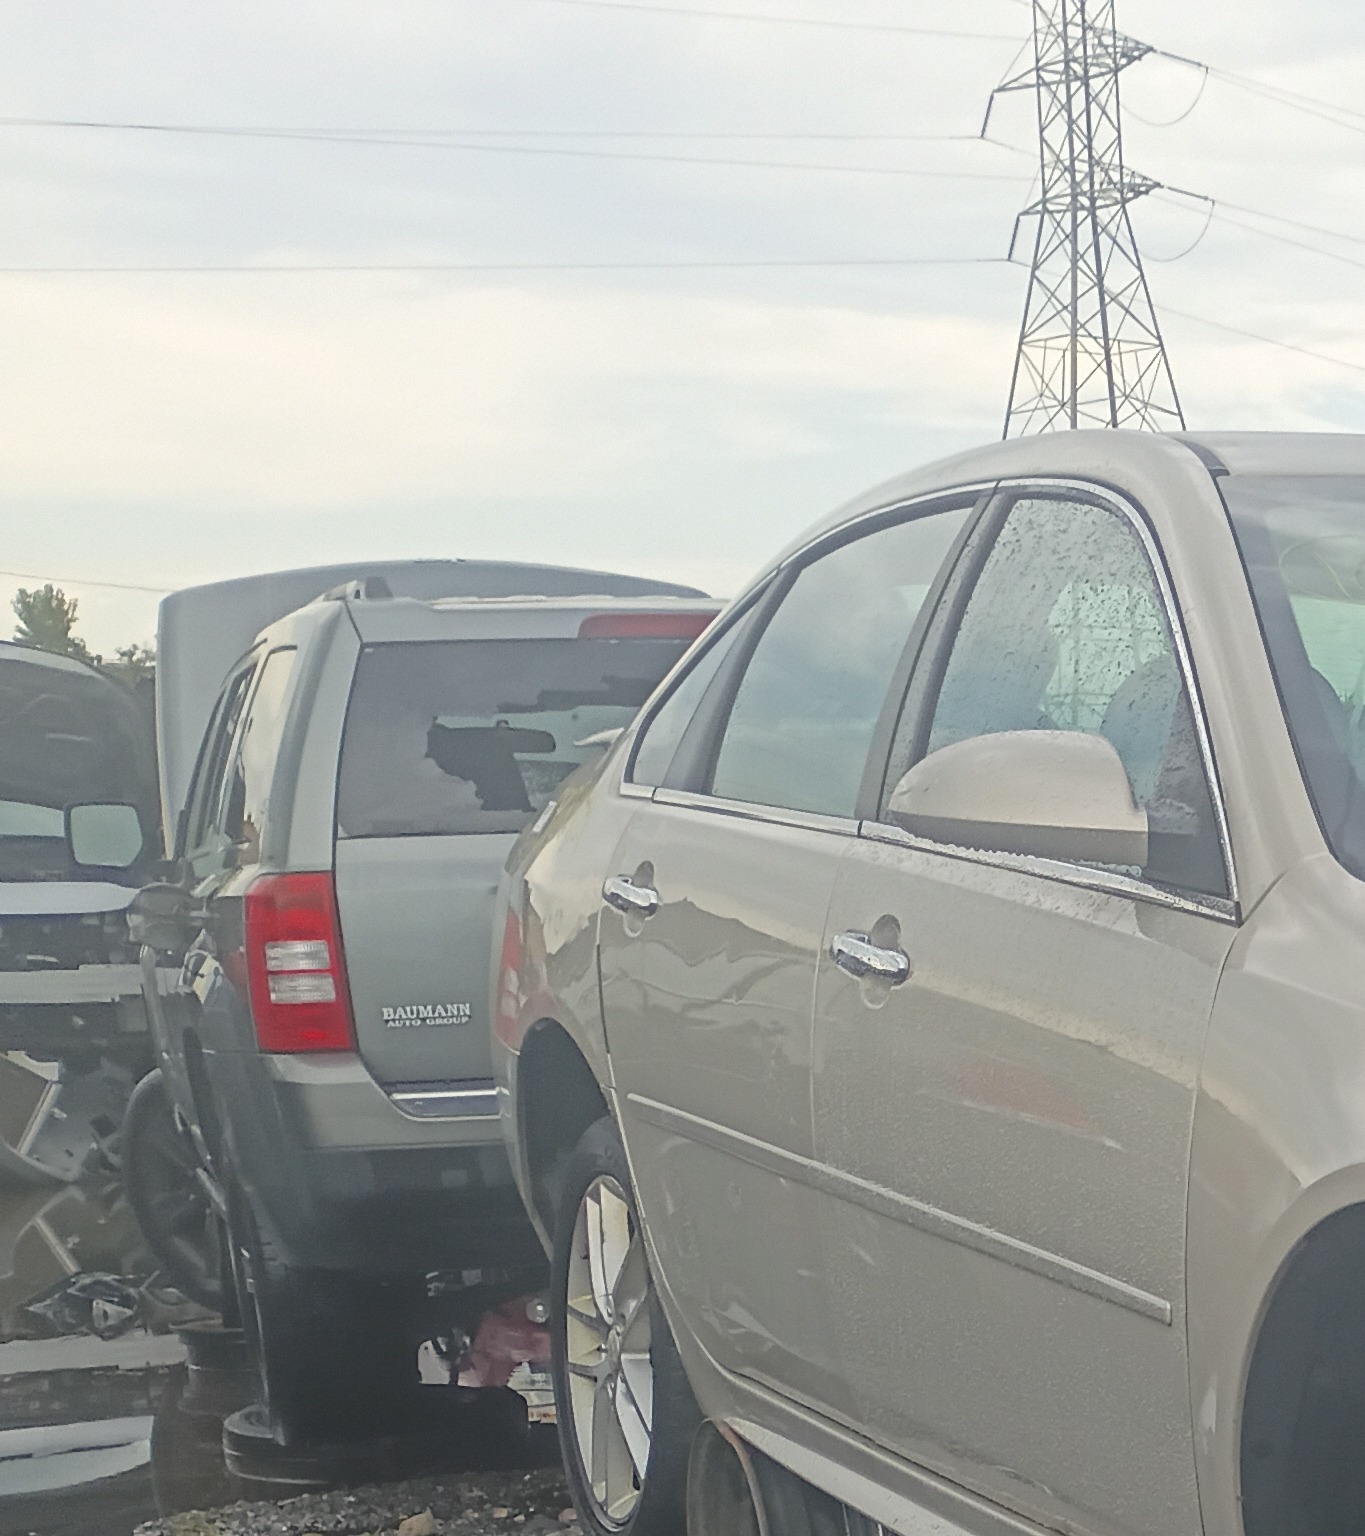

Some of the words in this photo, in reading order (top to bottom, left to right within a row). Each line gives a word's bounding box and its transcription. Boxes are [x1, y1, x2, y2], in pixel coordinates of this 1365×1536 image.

[382, 1003, 470, 1019] BAUMANN
[387, 1019, 421, 1027] AUTO
[426, 1016, 469, 1025] GROUP
